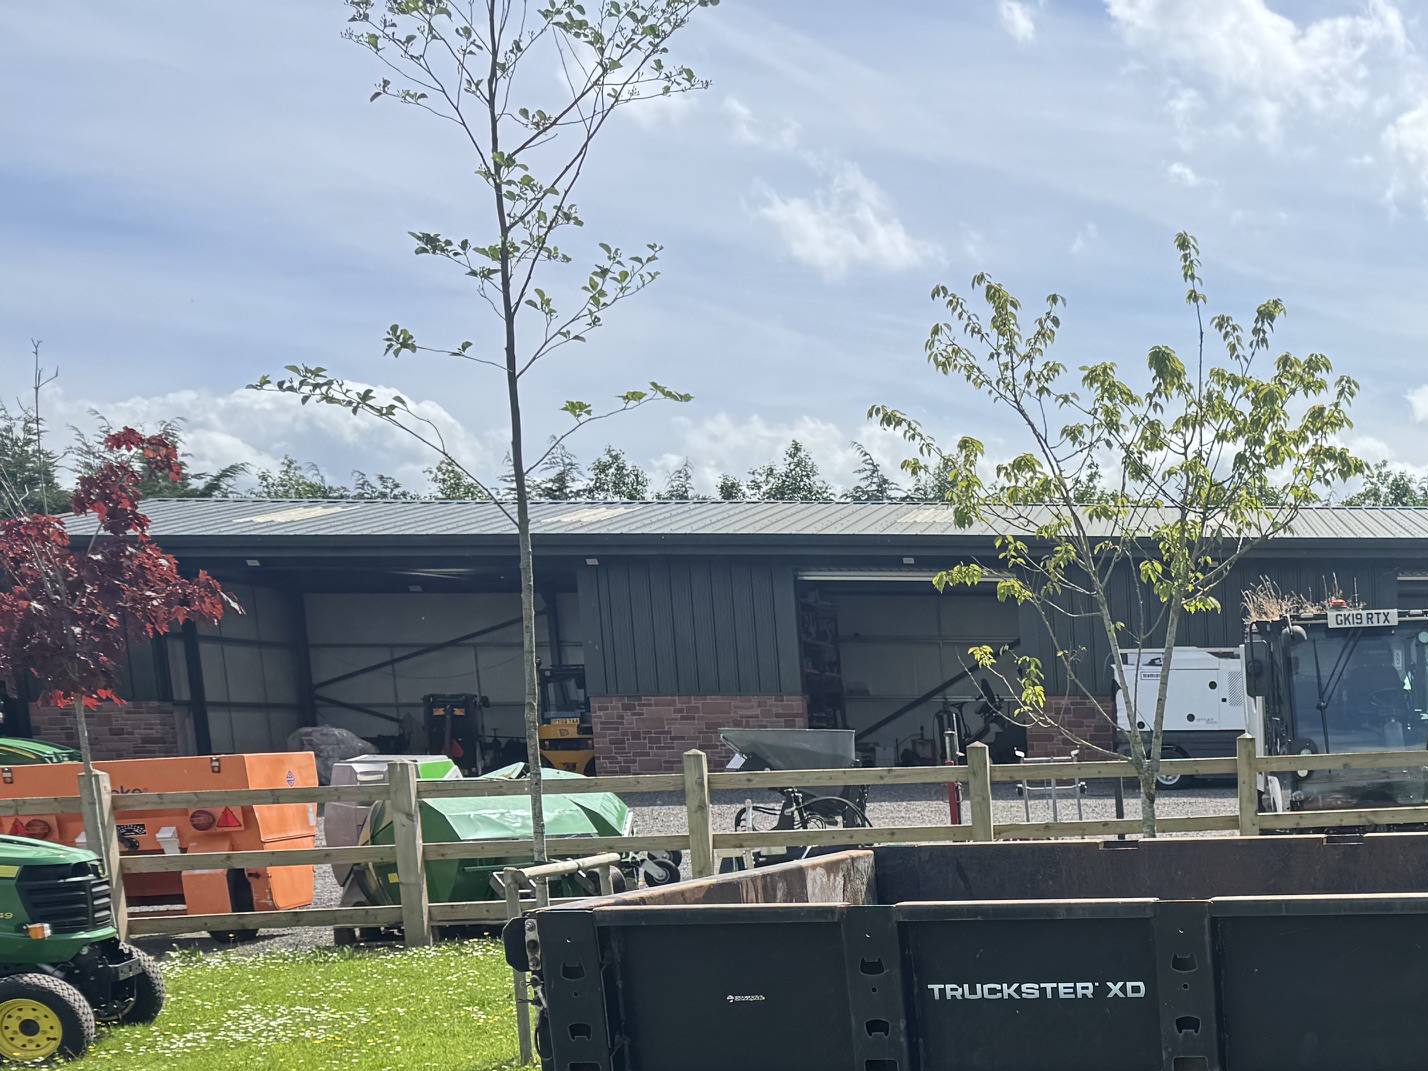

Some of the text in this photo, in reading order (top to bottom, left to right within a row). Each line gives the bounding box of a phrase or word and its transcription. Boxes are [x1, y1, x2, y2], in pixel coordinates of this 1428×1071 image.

[1335, 612, 1390, 625] GK19 RTX
[927, 981, 1146, 1000] TRUCKSTER XD
